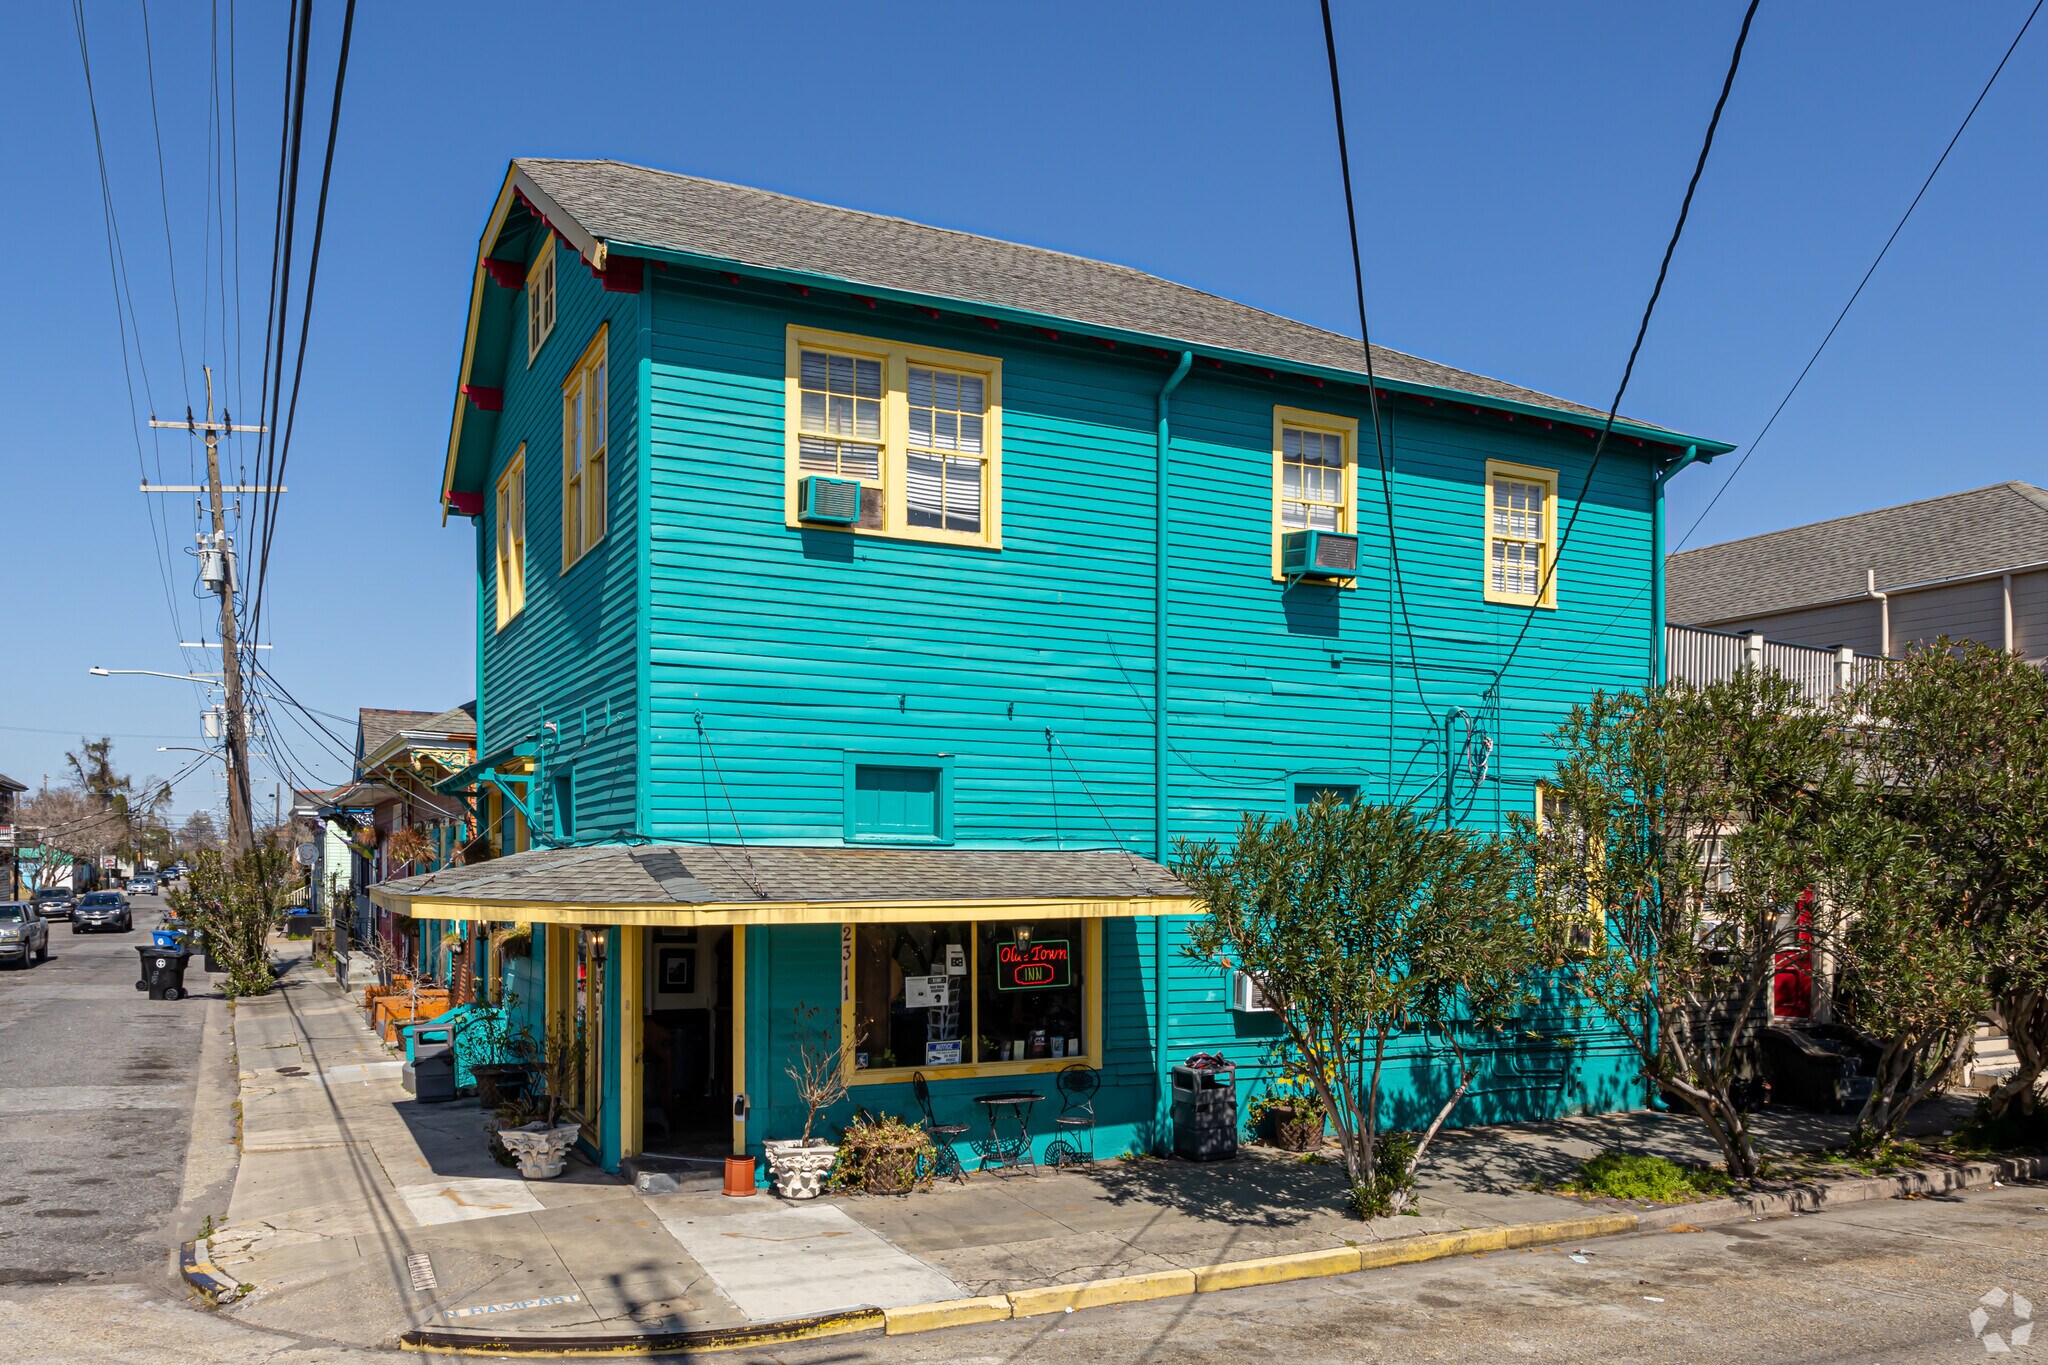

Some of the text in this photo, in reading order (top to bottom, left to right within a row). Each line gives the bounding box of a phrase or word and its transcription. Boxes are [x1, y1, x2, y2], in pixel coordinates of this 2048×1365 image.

[1031, 945, 1068, 960] Town
[843, 926, 852, 1002] 2311
[1024, 967, 1043, 981] INN
[444, 1310, 459, 1319] N
